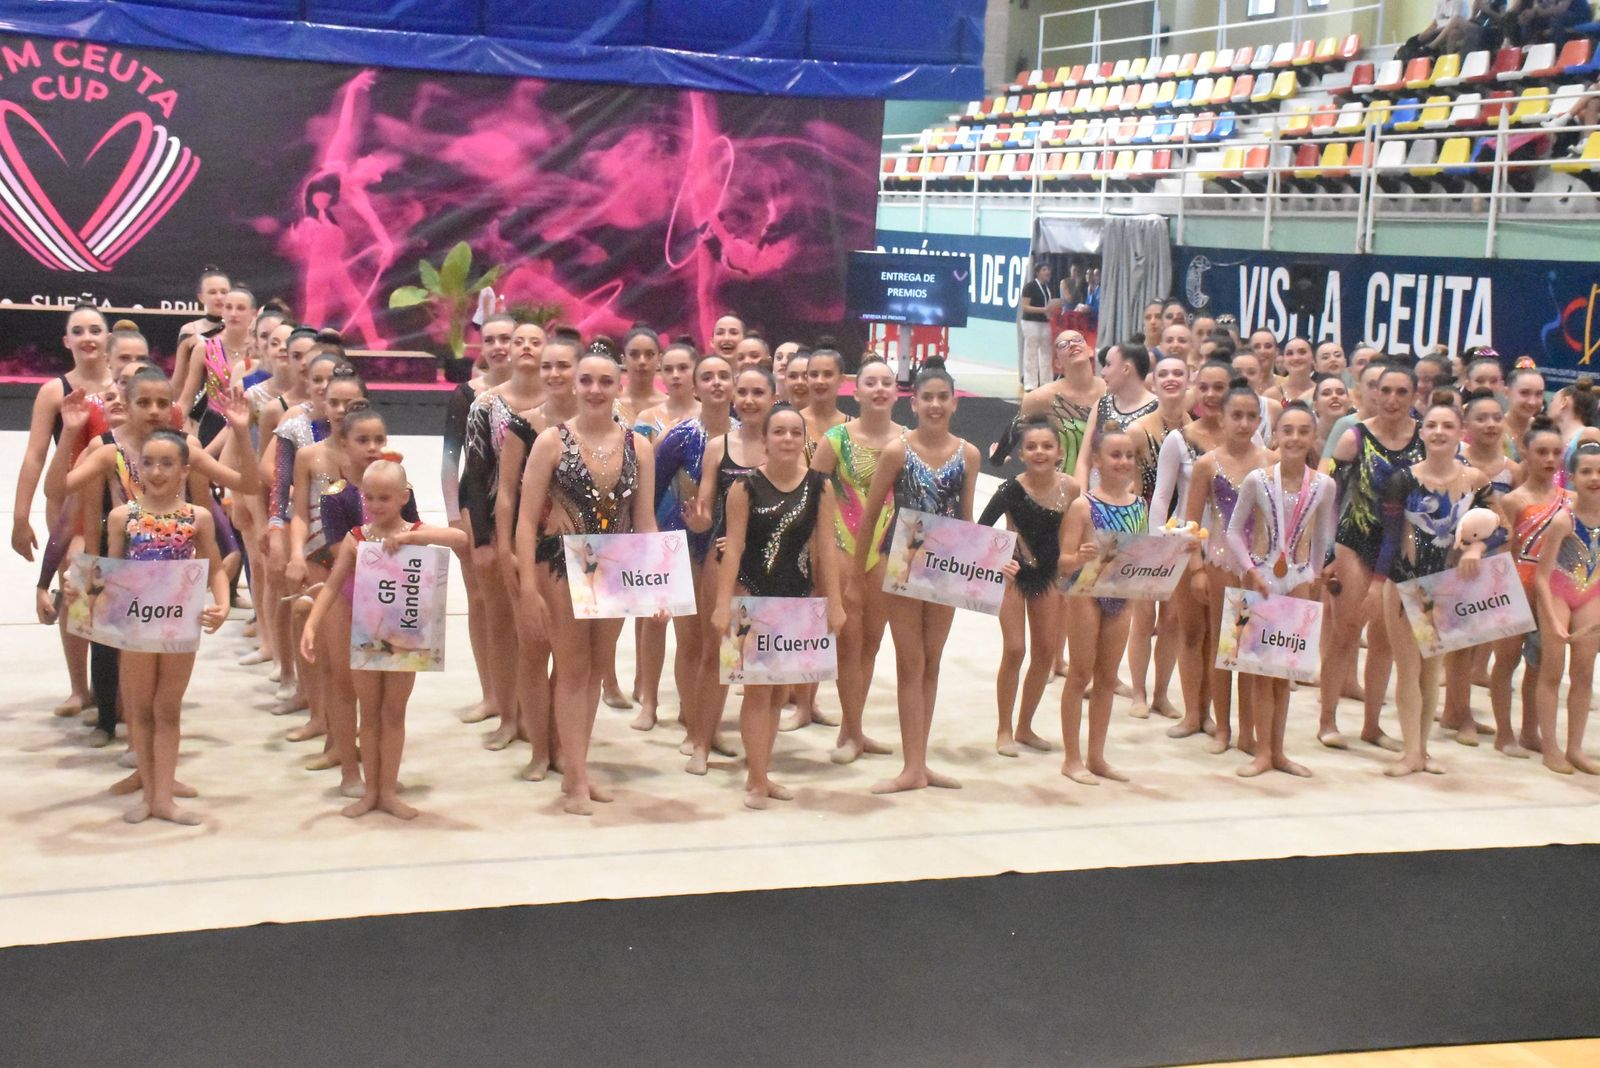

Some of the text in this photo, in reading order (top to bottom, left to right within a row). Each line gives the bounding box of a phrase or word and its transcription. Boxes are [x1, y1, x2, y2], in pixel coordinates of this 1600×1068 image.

[31, 76, 109, 103] CUP
[53, 39, 179, 119] CEUTA
[880, 271, 936, 283] ENTREGA DE
[980, 254, 1006, 306] DE
[887, 288, 928, 298] PREMIOS
[1364, 271, 1493, 360] CEUTA
[621, 569, 670, 587] Nácar
[925, 551, 1004, 585] Trebujena
[1120, 563, 1176, 579] Gymdal
[378, 579, 396, 604] GR
[400, 558, 422, 629] Kandela
[127, 597, 183, 622] Ágora
[757, 634, 830, 652] El Cuervo
[1261, 629, 1307, 654] Lebrija
